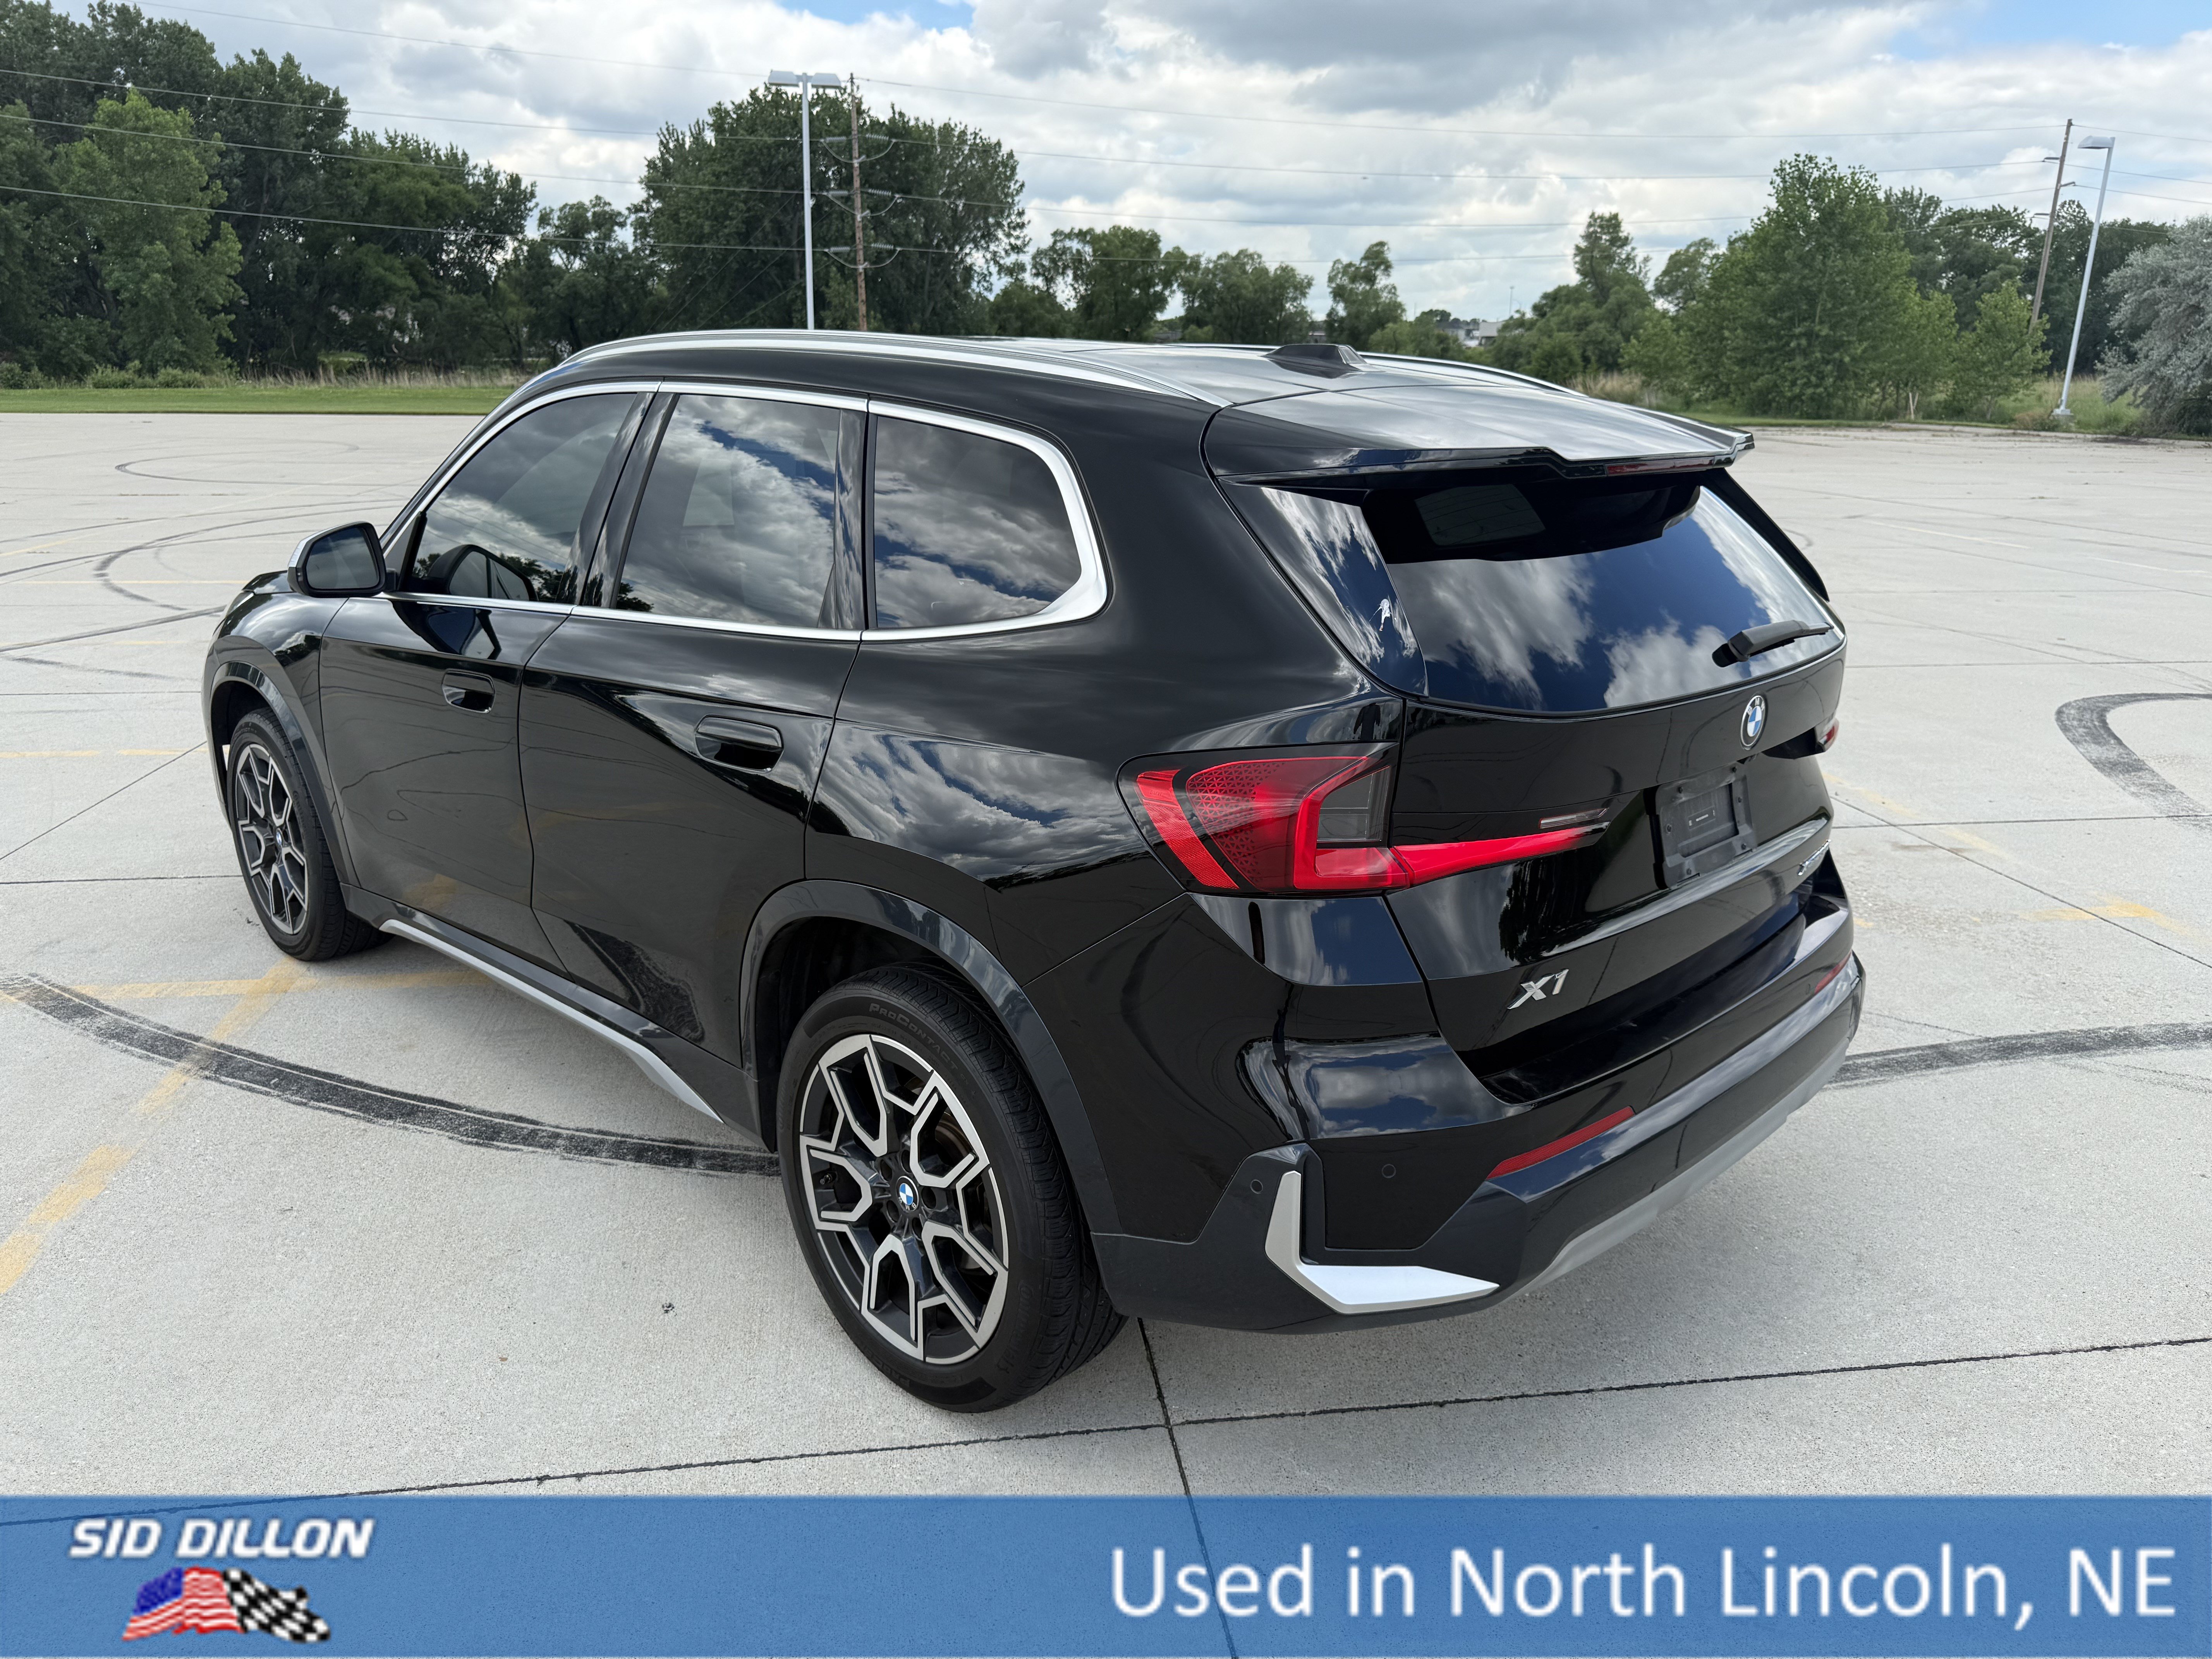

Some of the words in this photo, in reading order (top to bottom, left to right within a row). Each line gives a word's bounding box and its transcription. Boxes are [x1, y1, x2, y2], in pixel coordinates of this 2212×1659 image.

[1747, 697, 1765, 716] BMW
[1507, 969, 1569, 1009] X1
[898, 1197, 917, 1211] BMW
